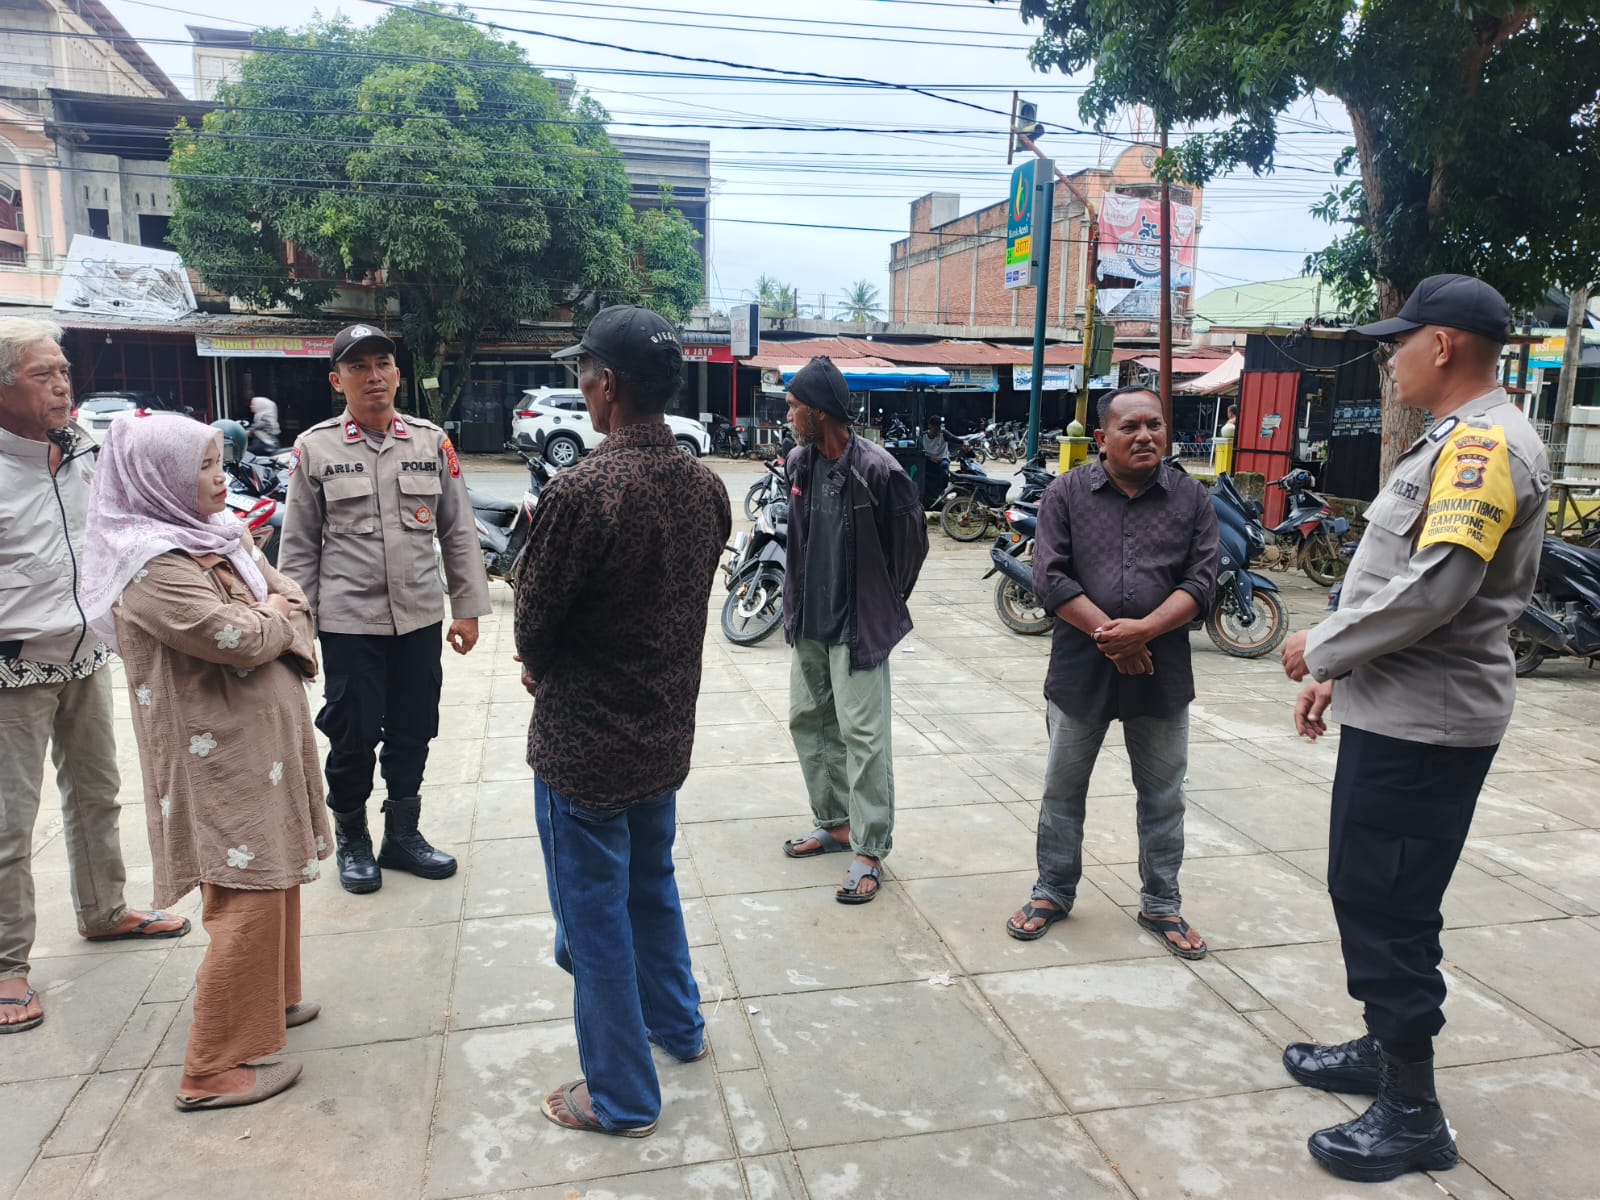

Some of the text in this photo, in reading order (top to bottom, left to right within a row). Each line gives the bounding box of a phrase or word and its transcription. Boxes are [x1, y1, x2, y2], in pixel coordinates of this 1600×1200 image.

[694, 347, 713, 356] JAYA
[324, 462, 364, 476] ARI.S
[401, 461, 437, 471] POLRI
[1431, 514, 1485, 531] GAMPONG
[1467, 527, 1486, 543] PASE
